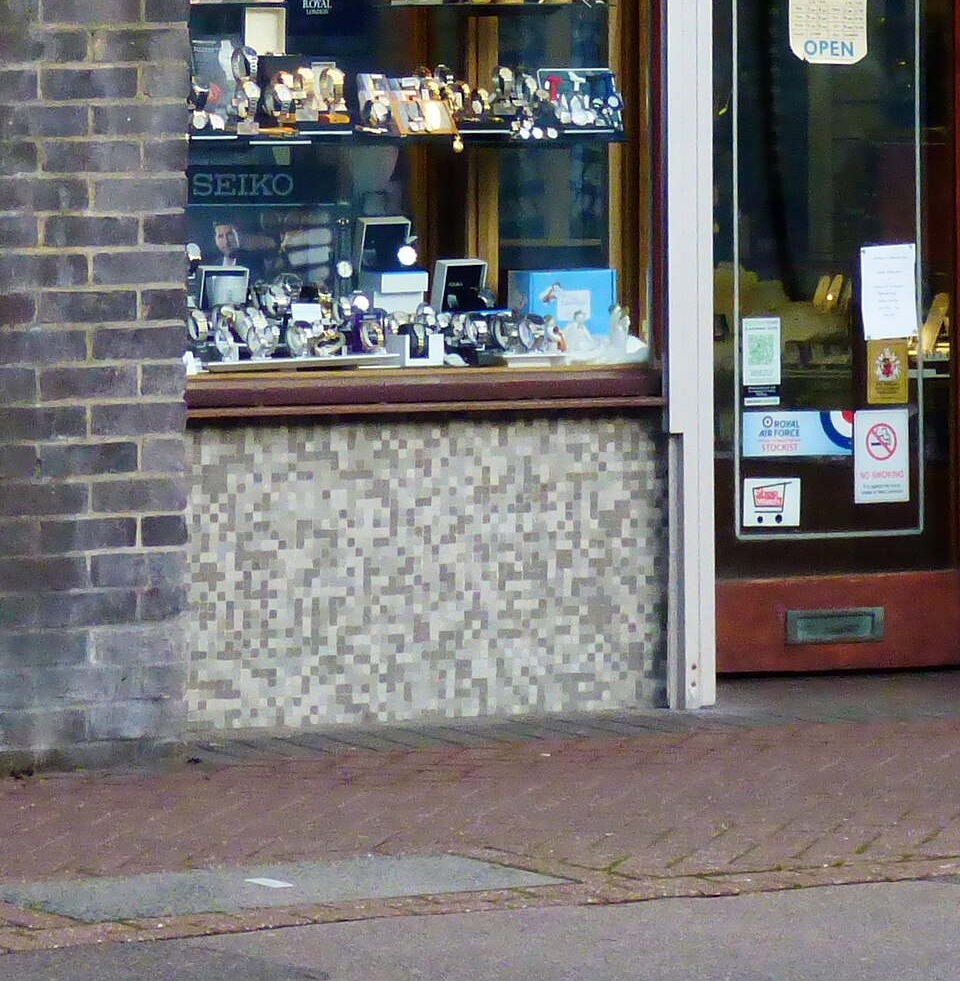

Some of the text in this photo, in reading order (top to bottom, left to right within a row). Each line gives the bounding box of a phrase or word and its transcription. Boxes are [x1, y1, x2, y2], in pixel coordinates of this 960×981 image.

[302, 0, 333, 9] ROYAL
[804, 40, 854, 57] OPEN
[193, 173, 294, 197] SEIKO
[773, 420, 800, 428] ROYAL
[758, 429, 800, 437] AIR FORCE
[761, 443, 798, 452] STOCKIST
